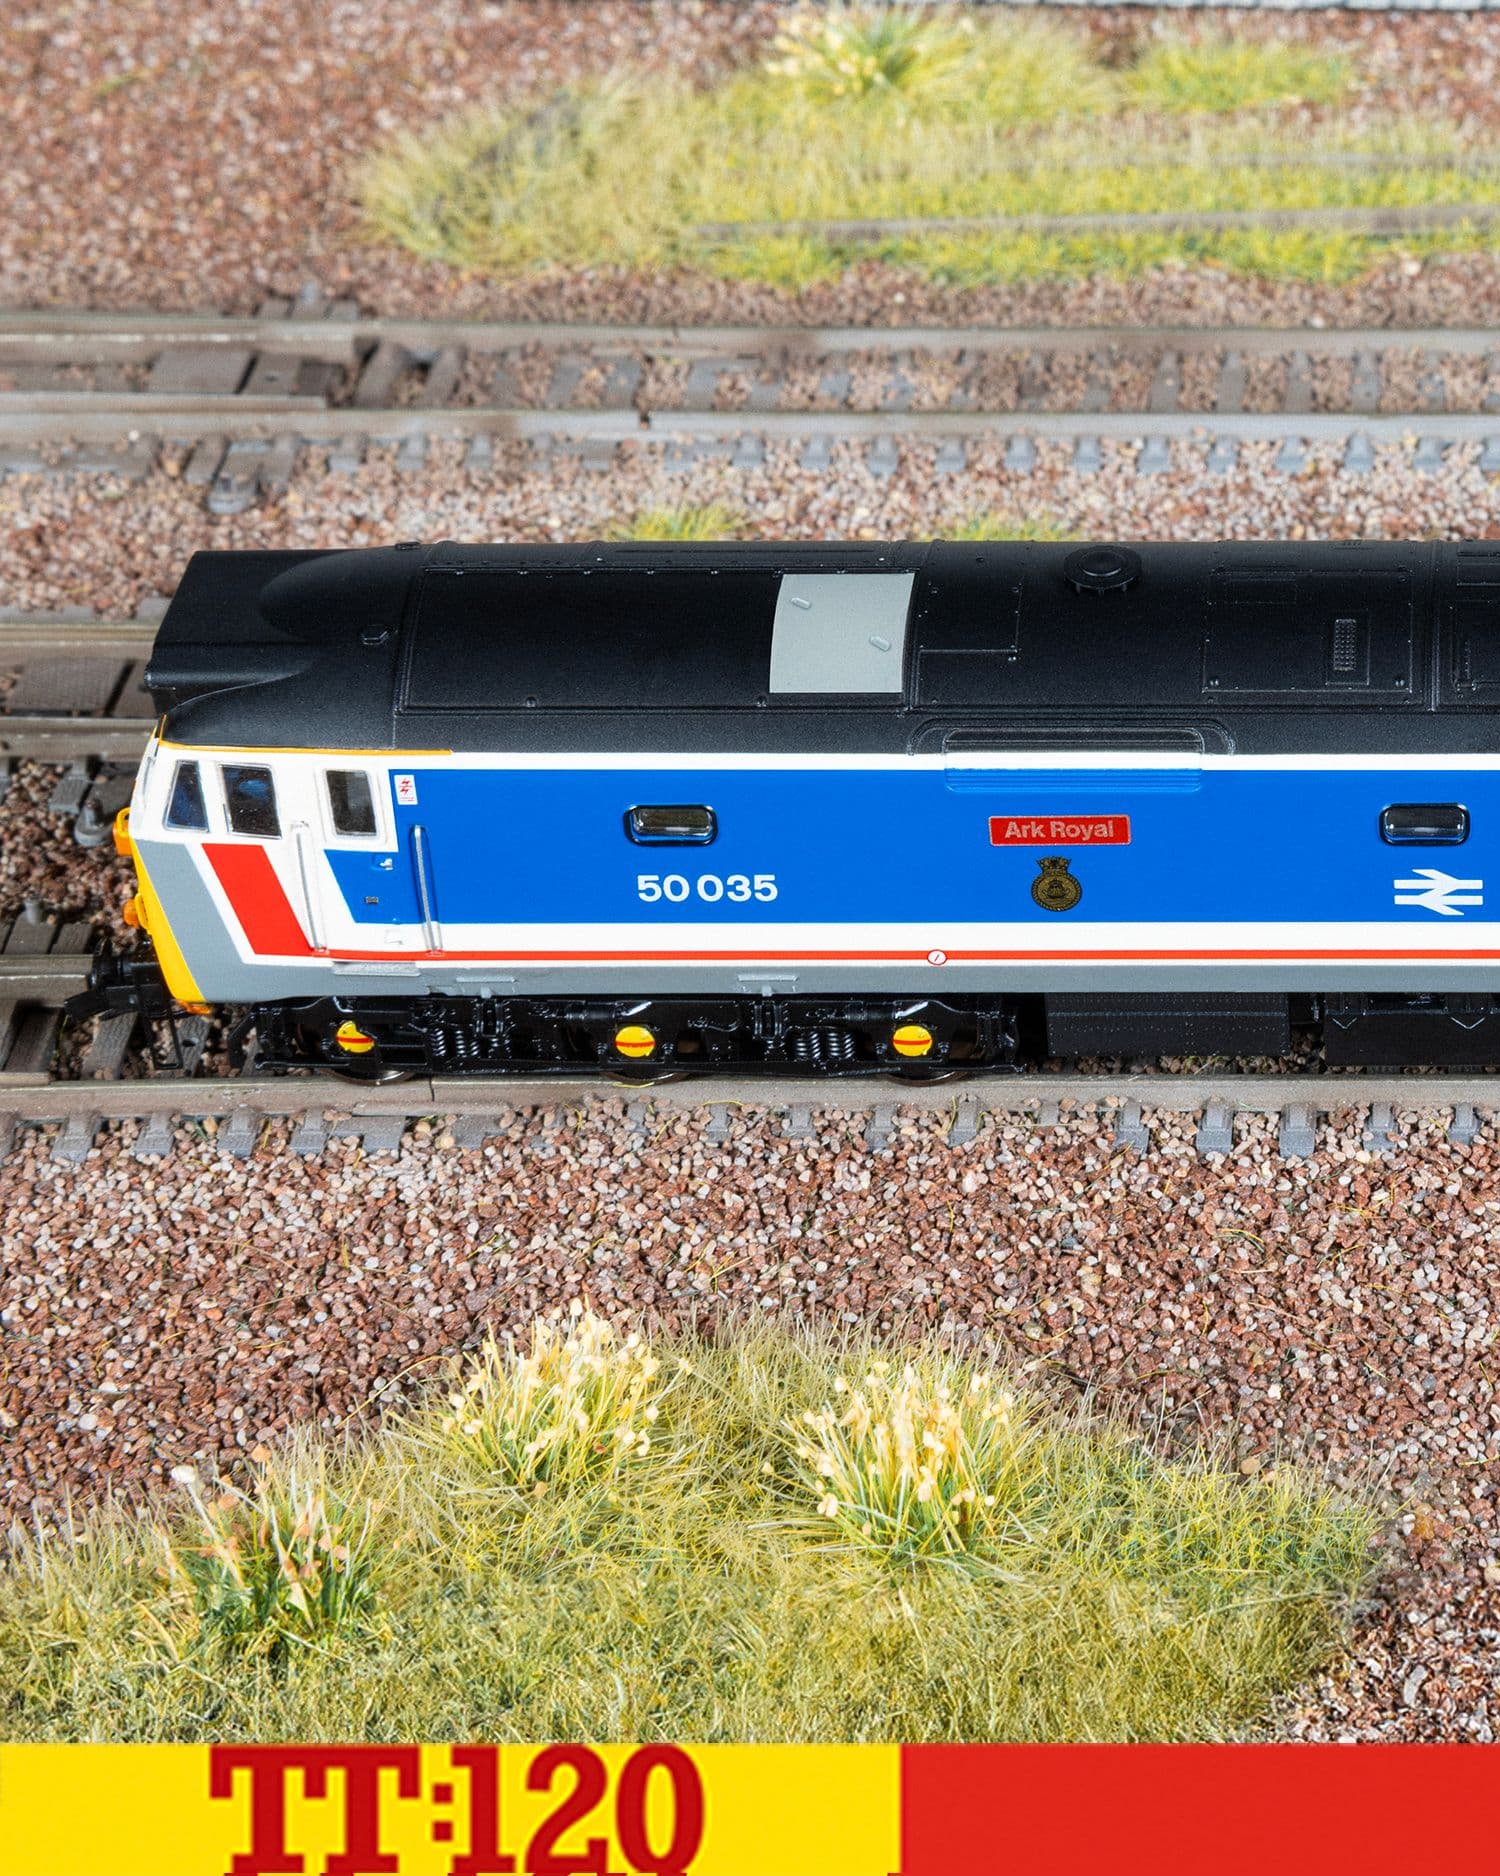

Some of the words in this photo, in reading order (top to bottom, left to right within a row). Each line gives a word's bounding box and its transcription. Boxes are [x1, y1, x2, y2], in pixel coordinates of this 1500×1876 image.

[1005, 821, 1046, 838] Ark
[1050, 820, 1114, 841] Royal
[637, 874, 690, 902] 50
[696, 874, 778, 902] 035
